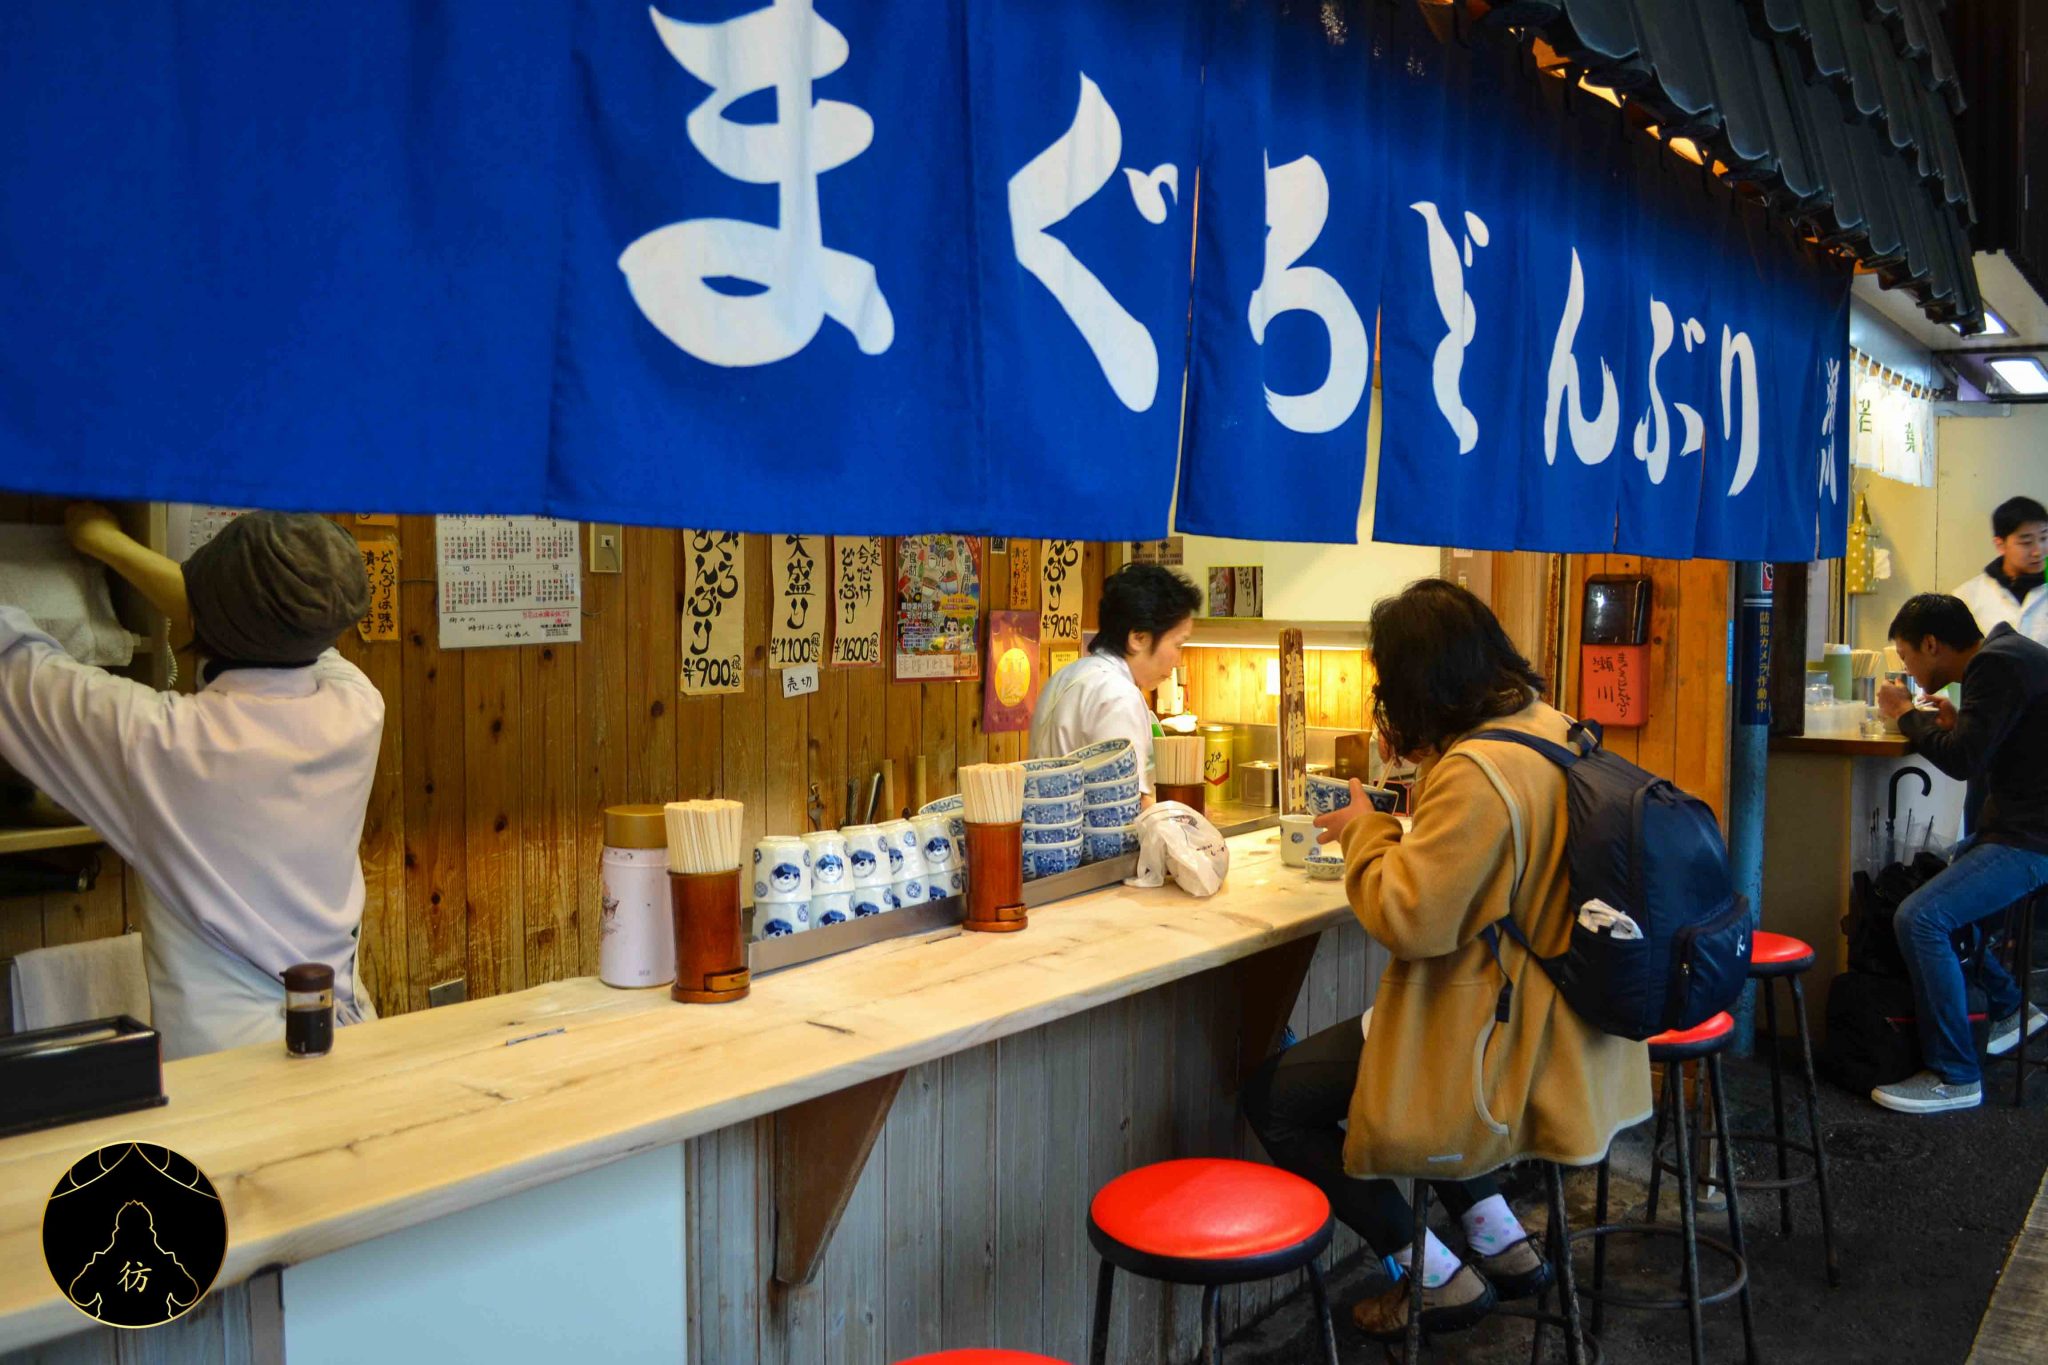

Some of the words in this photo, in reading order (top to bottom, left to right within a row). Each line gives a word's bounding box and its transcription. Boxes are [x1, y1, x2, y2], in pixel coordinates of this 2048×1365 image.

[617, 0, 1760, 498] まぐろどんぶり
[784, 534, 816, 629] 大盛り
[839, 547, 859, 624] どんぶり
[857, 544, 872, 607] 今だけ
[771, 637, 811, 663] ¥1100
[834, 637, 869, 661] ¥1600
[1042, 614, 1072, 639] ¥900
[682, 657, 731, 688] ¥900
[787, 676, 812, 691] 売切
[1757, 611, 1770, 713] 防犯カメラ作動中
